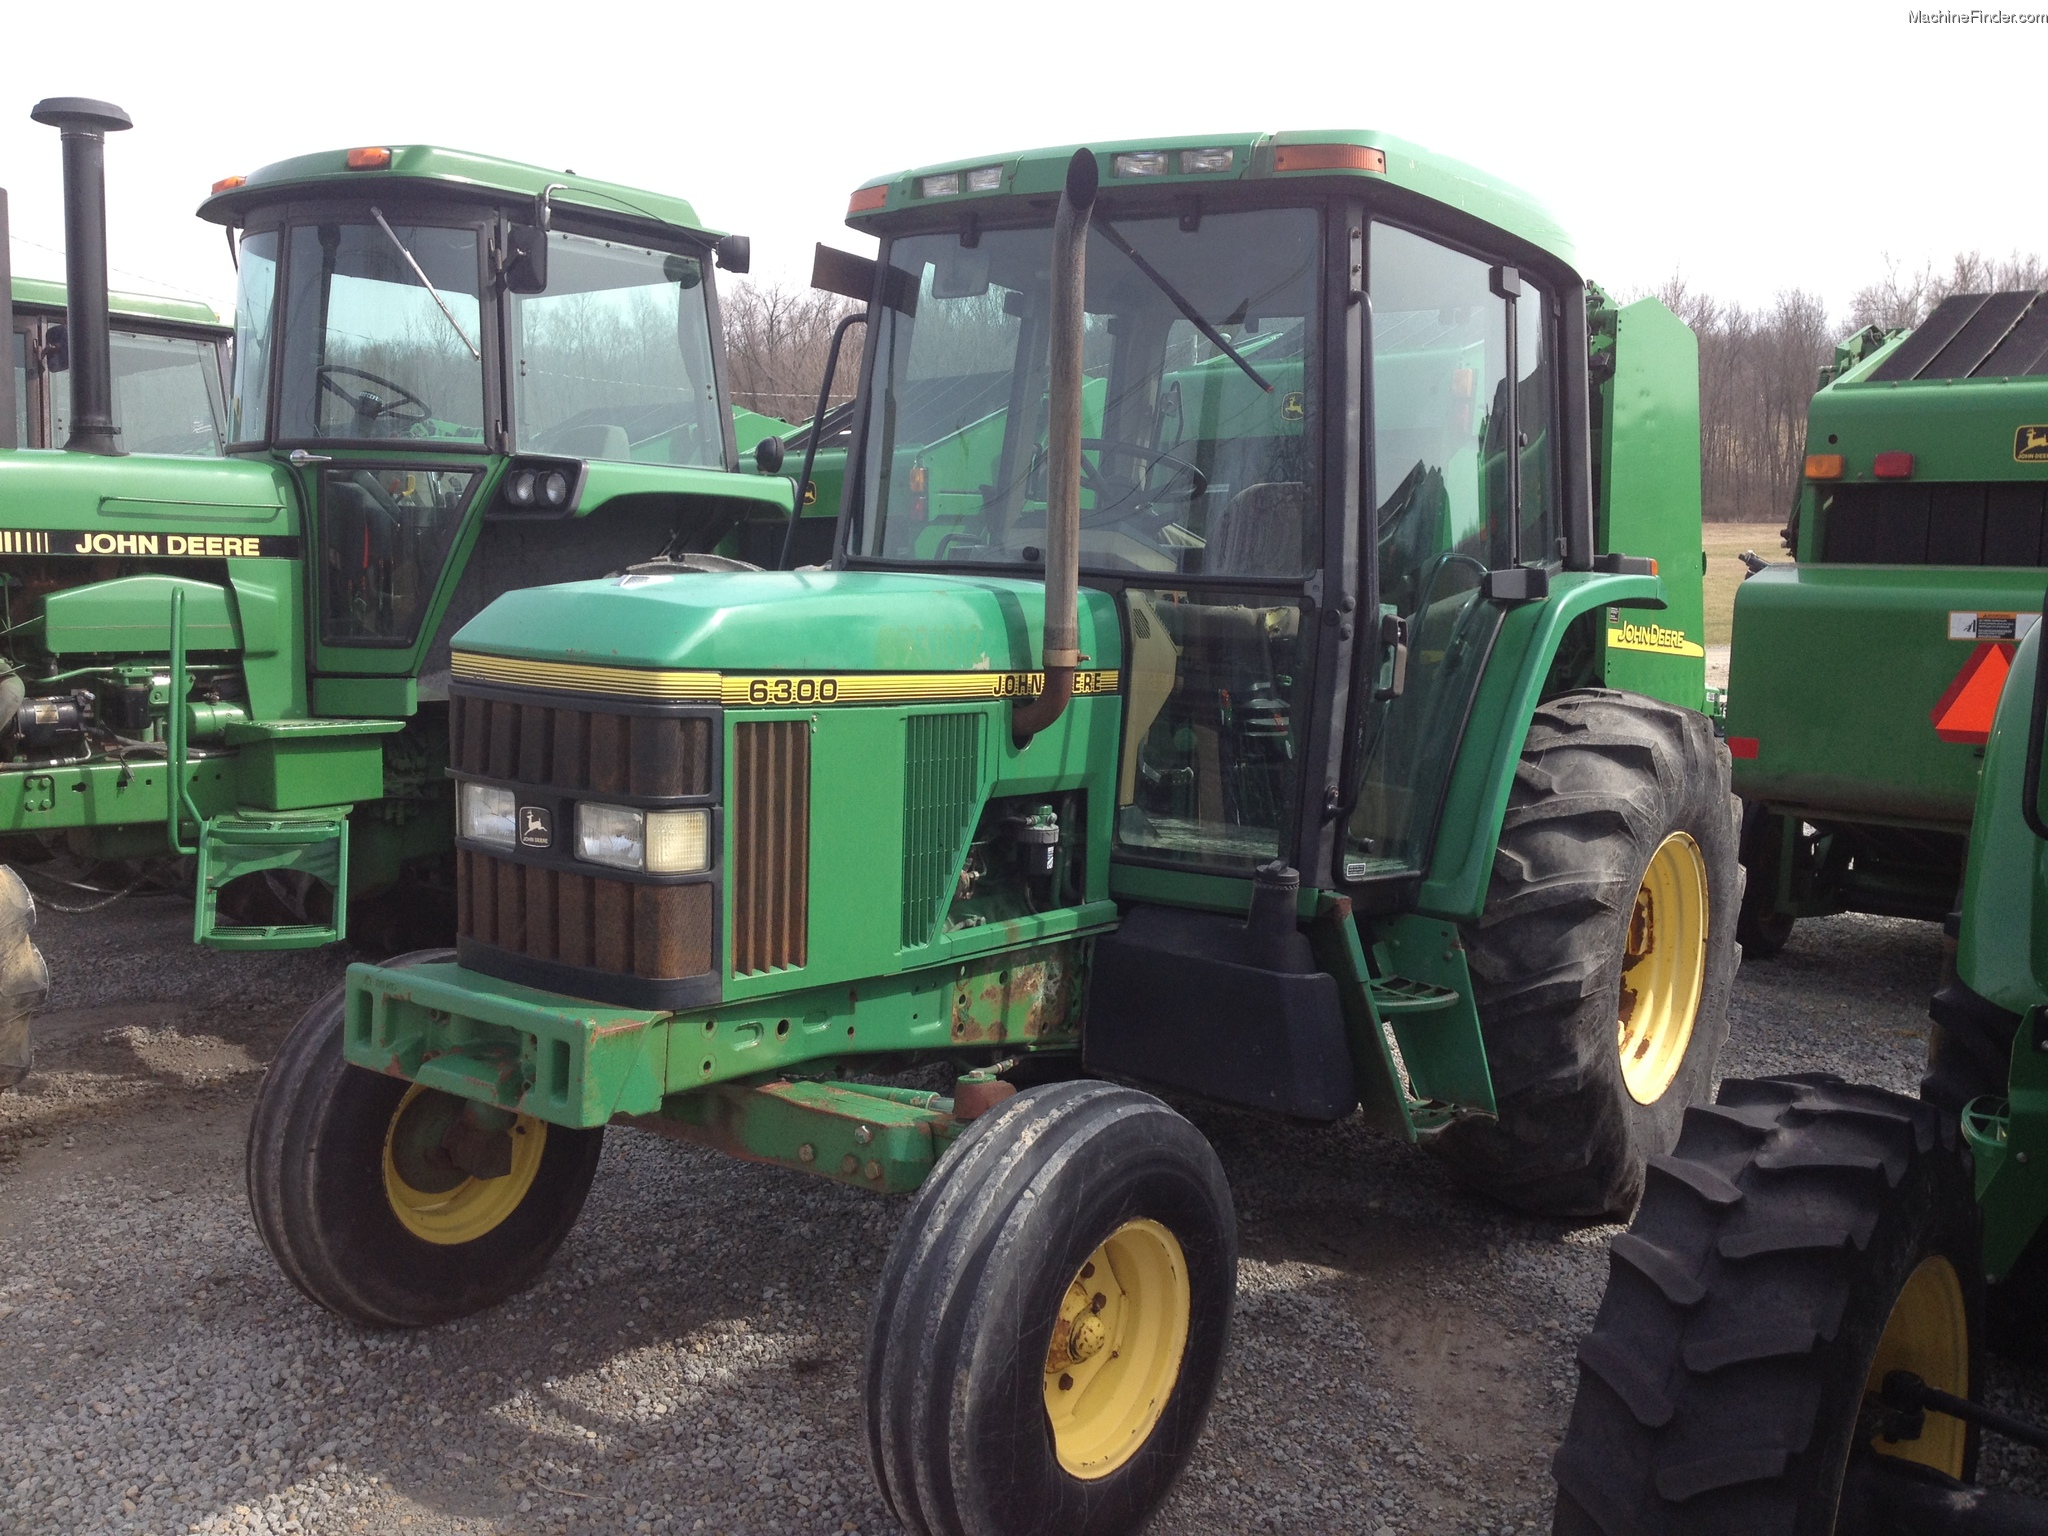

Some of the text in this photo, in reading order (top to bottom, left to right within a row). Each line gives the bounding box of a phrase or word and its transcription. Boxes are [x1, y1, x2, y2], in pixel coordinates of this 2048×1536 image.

[75, 533, 260, 556] JOHN DEERE
[749, 678, 839, 704] 6300
[993, 672, 1101, 697] JOHN ERE
